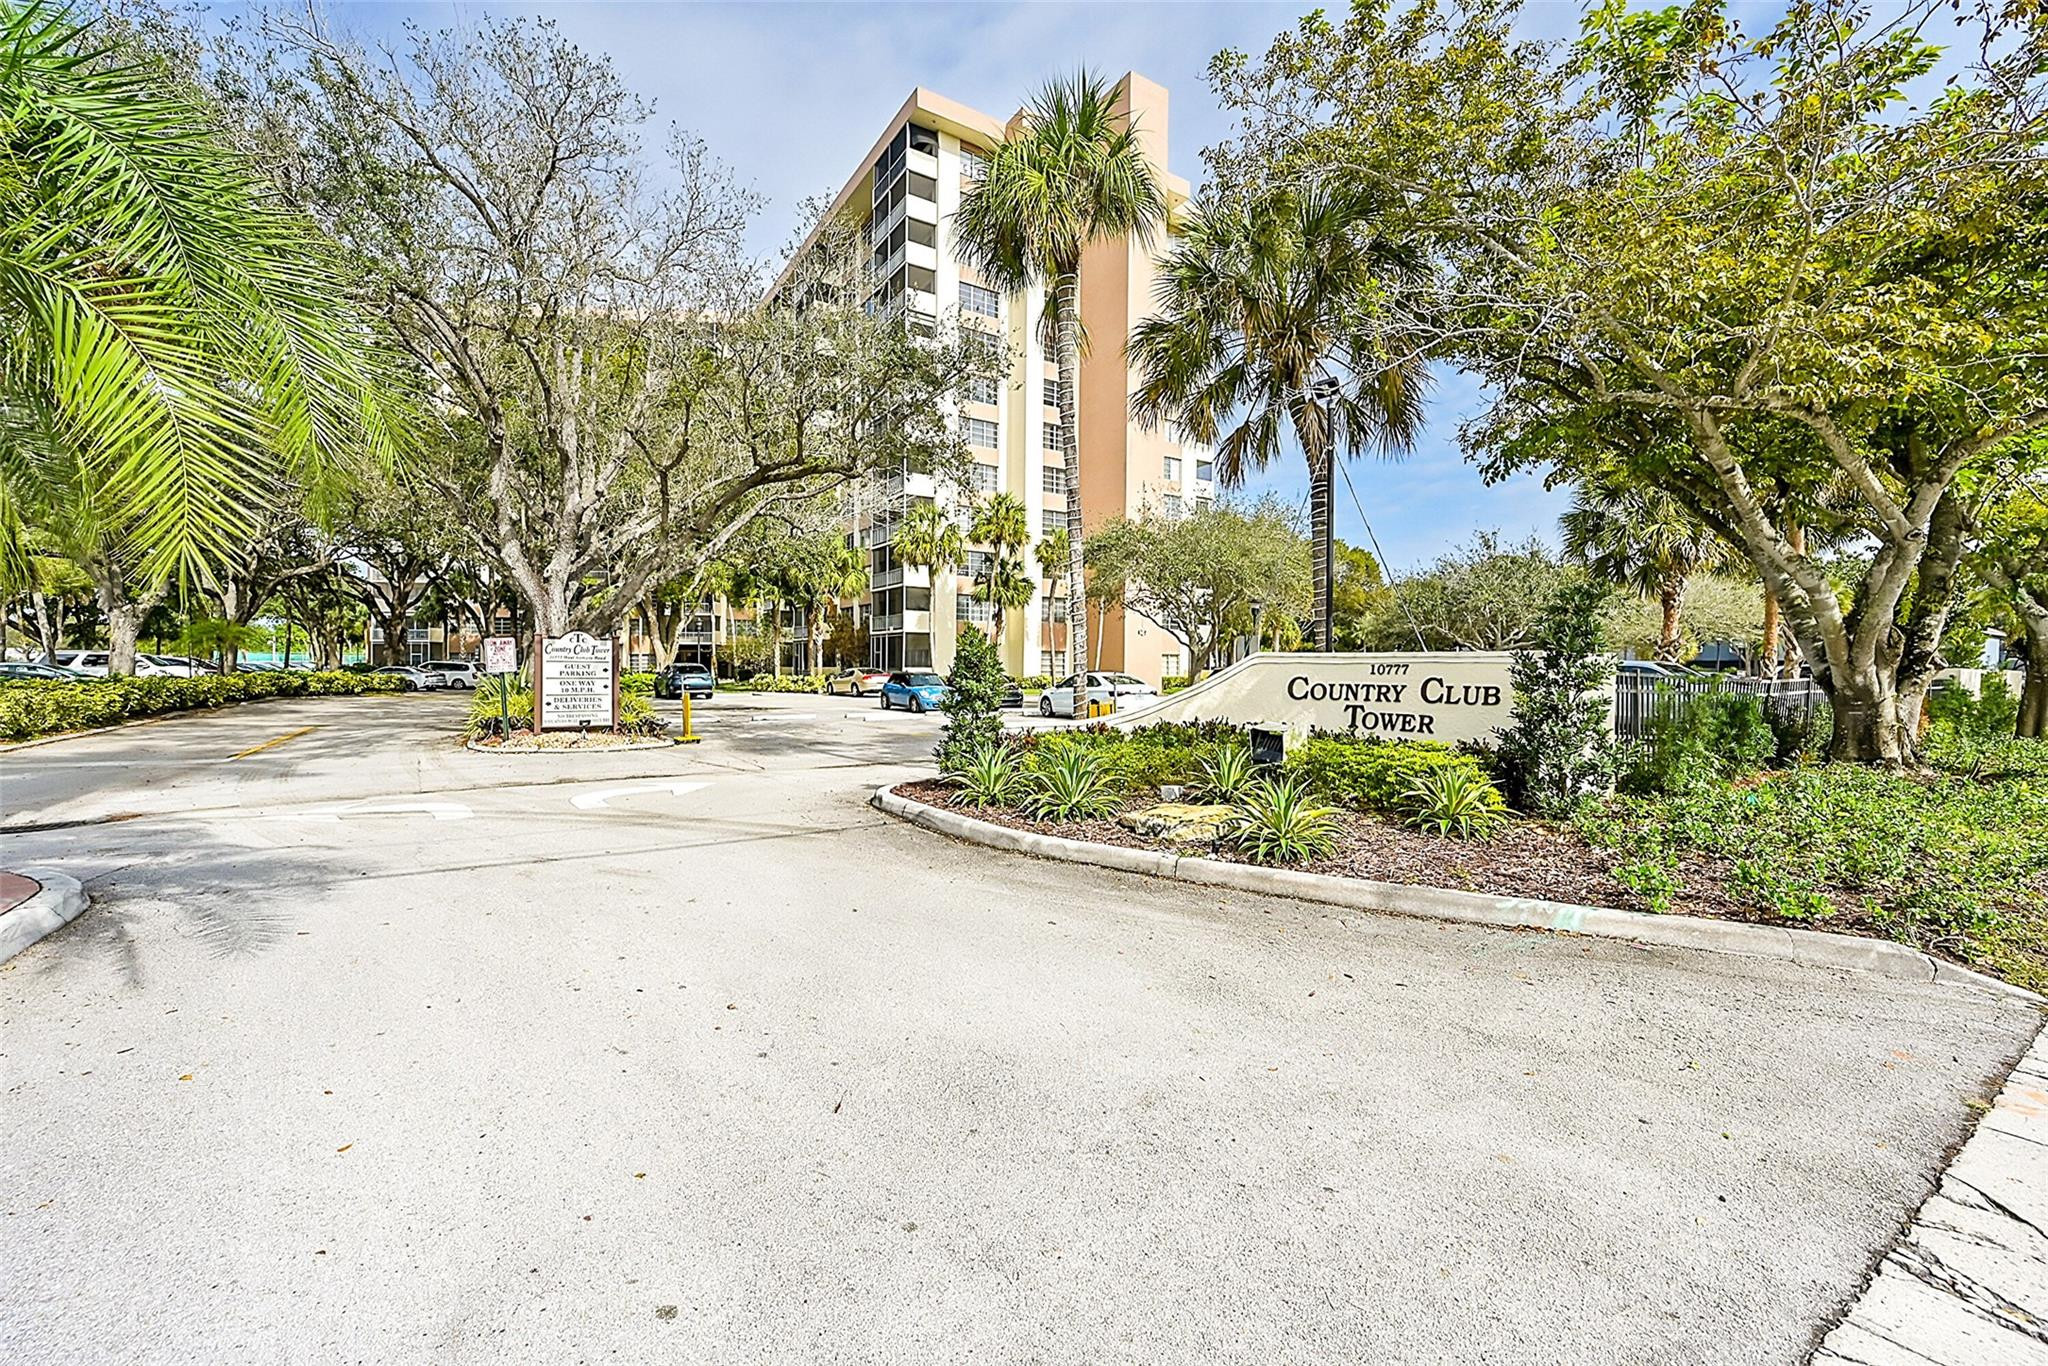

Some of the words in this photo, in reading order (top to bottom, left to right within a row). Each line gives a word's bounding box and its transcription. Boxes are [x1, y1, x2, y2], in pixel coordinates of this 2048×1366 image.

[544, 643, 572, 655] Country
[573, 644, 590, 655] Club
[591, 645, 610, 655] Tower
[1370, 664, 1409, 675] 10777
[1287, 676, 1407, 703] COUNTRY
[1420, 677, 1501, 706] CLUB
[1344, 705, 1435, 734] TOWER
